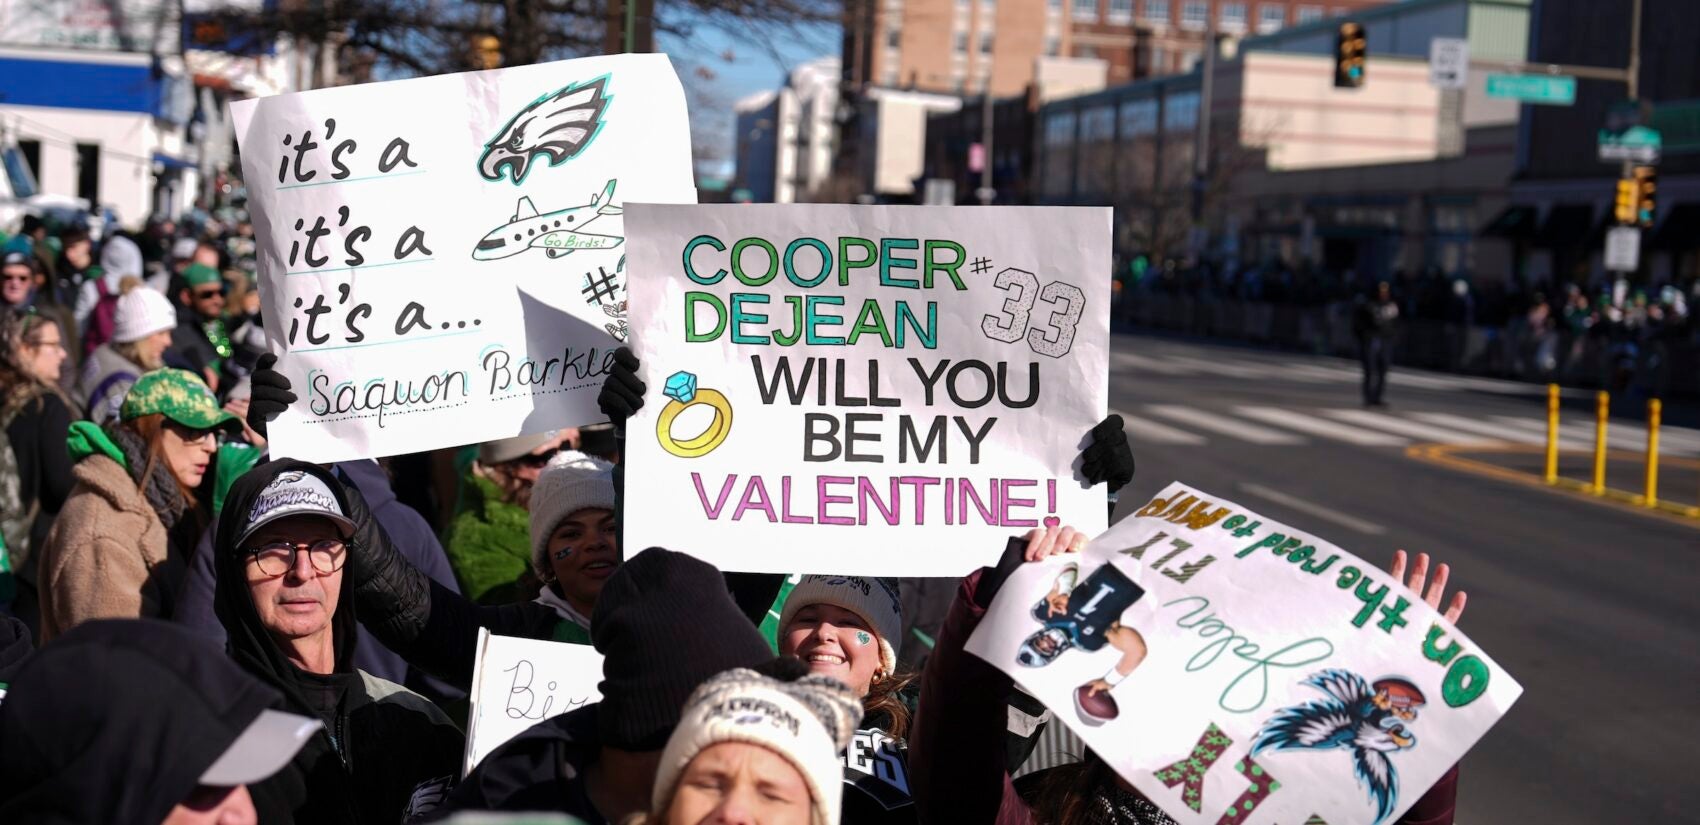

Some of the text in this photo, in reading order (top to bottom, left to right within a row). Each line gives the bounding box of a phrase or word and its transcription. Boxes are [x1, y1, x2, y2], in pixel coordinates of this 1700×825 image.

[278, 118, 418, 184] it's a
[289, 205, 433, 268] it's a
[544, 234, 606, 247] Go Birds!
[682, 235, 968, 290] COOPER
[289, 283, 482, 346] it's a...
[685, 291, 938, 349] DEJEAN
[310, 347, 616, 428] Saquon Barkle
[751, 354, 1040, 409] WILL YOU
[803, 412, 998, 465] BE MY
[690, 472, 1060, 528] VALENTINE!
[1116, 530, 1217, 585] FLY
[1135, 490, 1490, 709] On the road to MVP
[1162, 596, 1334, 713] Jalen
[503, 659, 589, 721] Bir
[841, 727, 911, 797] ES
[1153, 722, 1328, 825] LY
